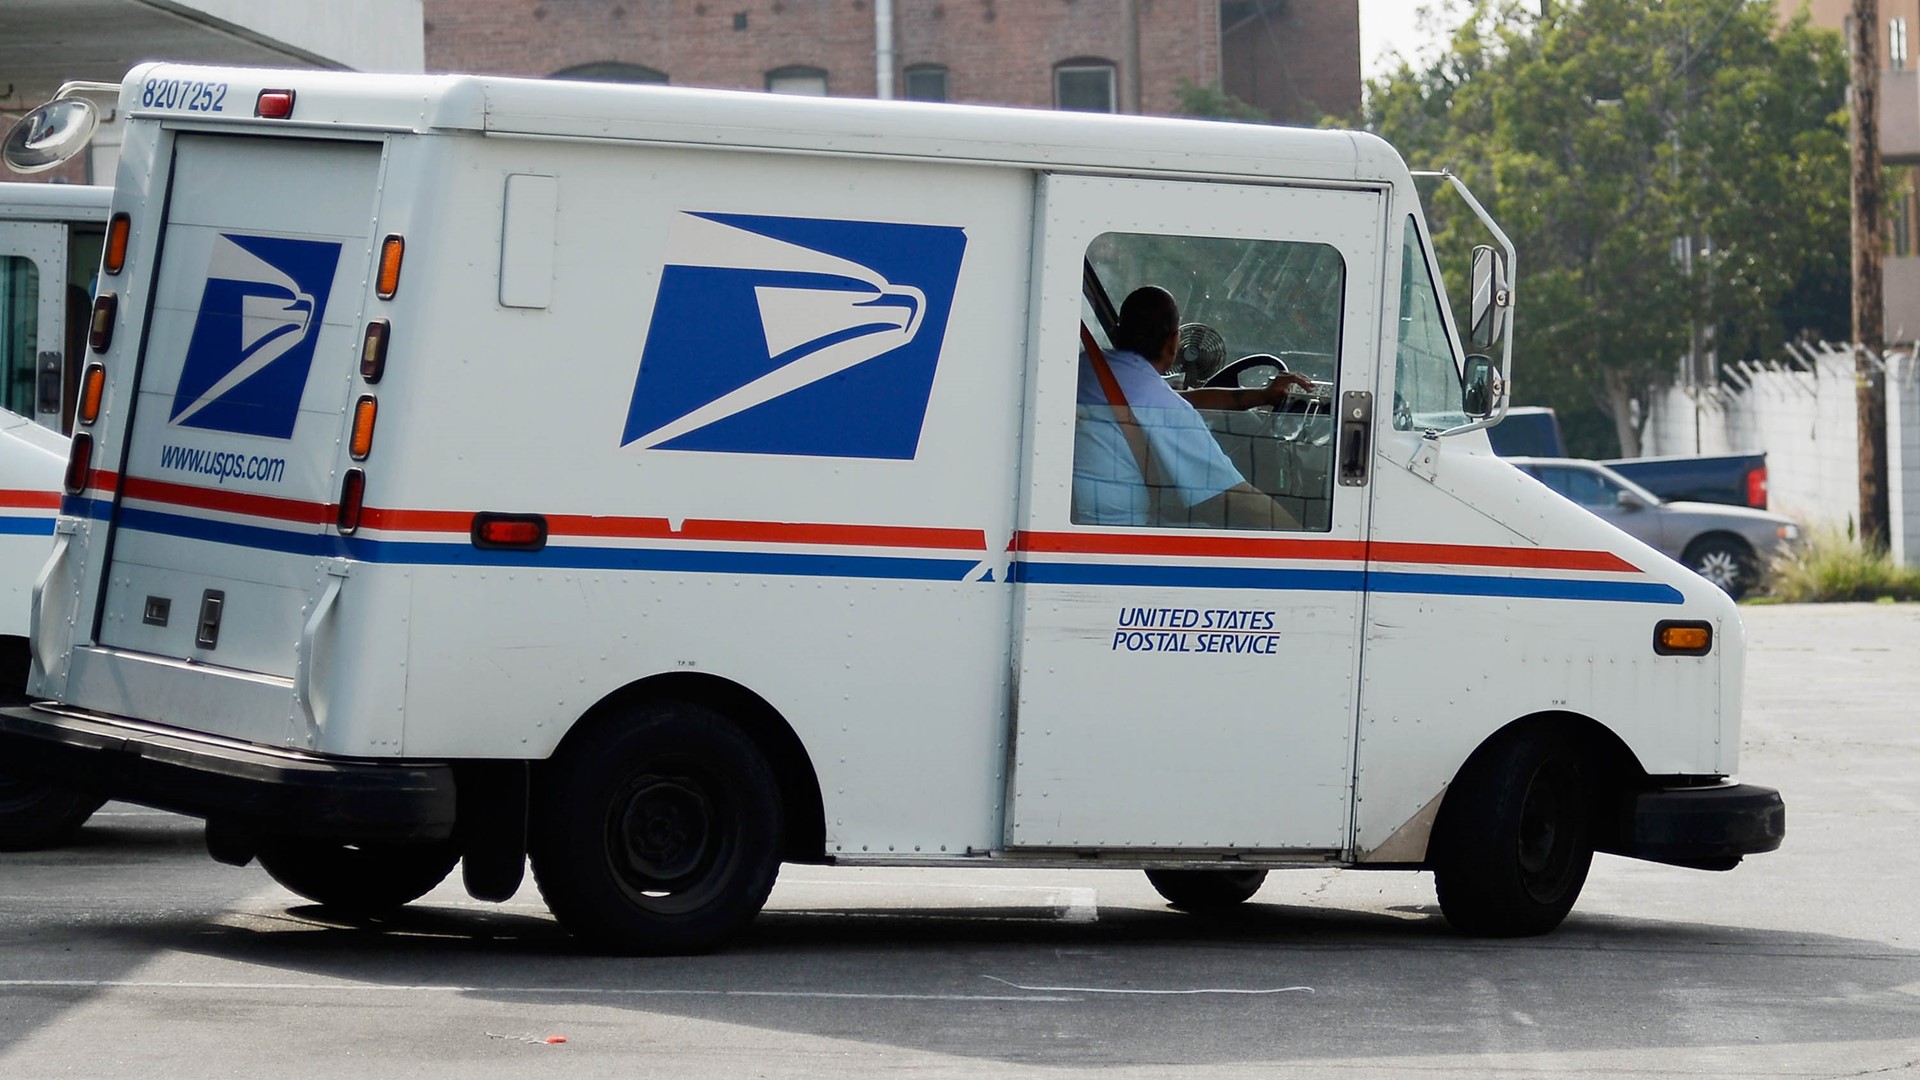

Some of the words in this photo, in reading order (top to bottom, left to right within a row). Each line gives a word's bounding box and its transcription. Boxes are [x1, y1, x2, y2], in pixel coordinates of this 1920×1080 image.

[143, 79, 228, 112] 8207252
[160, 445, 286, 484] www.usps.com
[1118, 607, 1199, 628] UNITED
[1201, 609, 1276, 630] STATES
[1112, 631, 1191, 652] POSTAL
[1194, 633, 1281, 654] SERVICE
